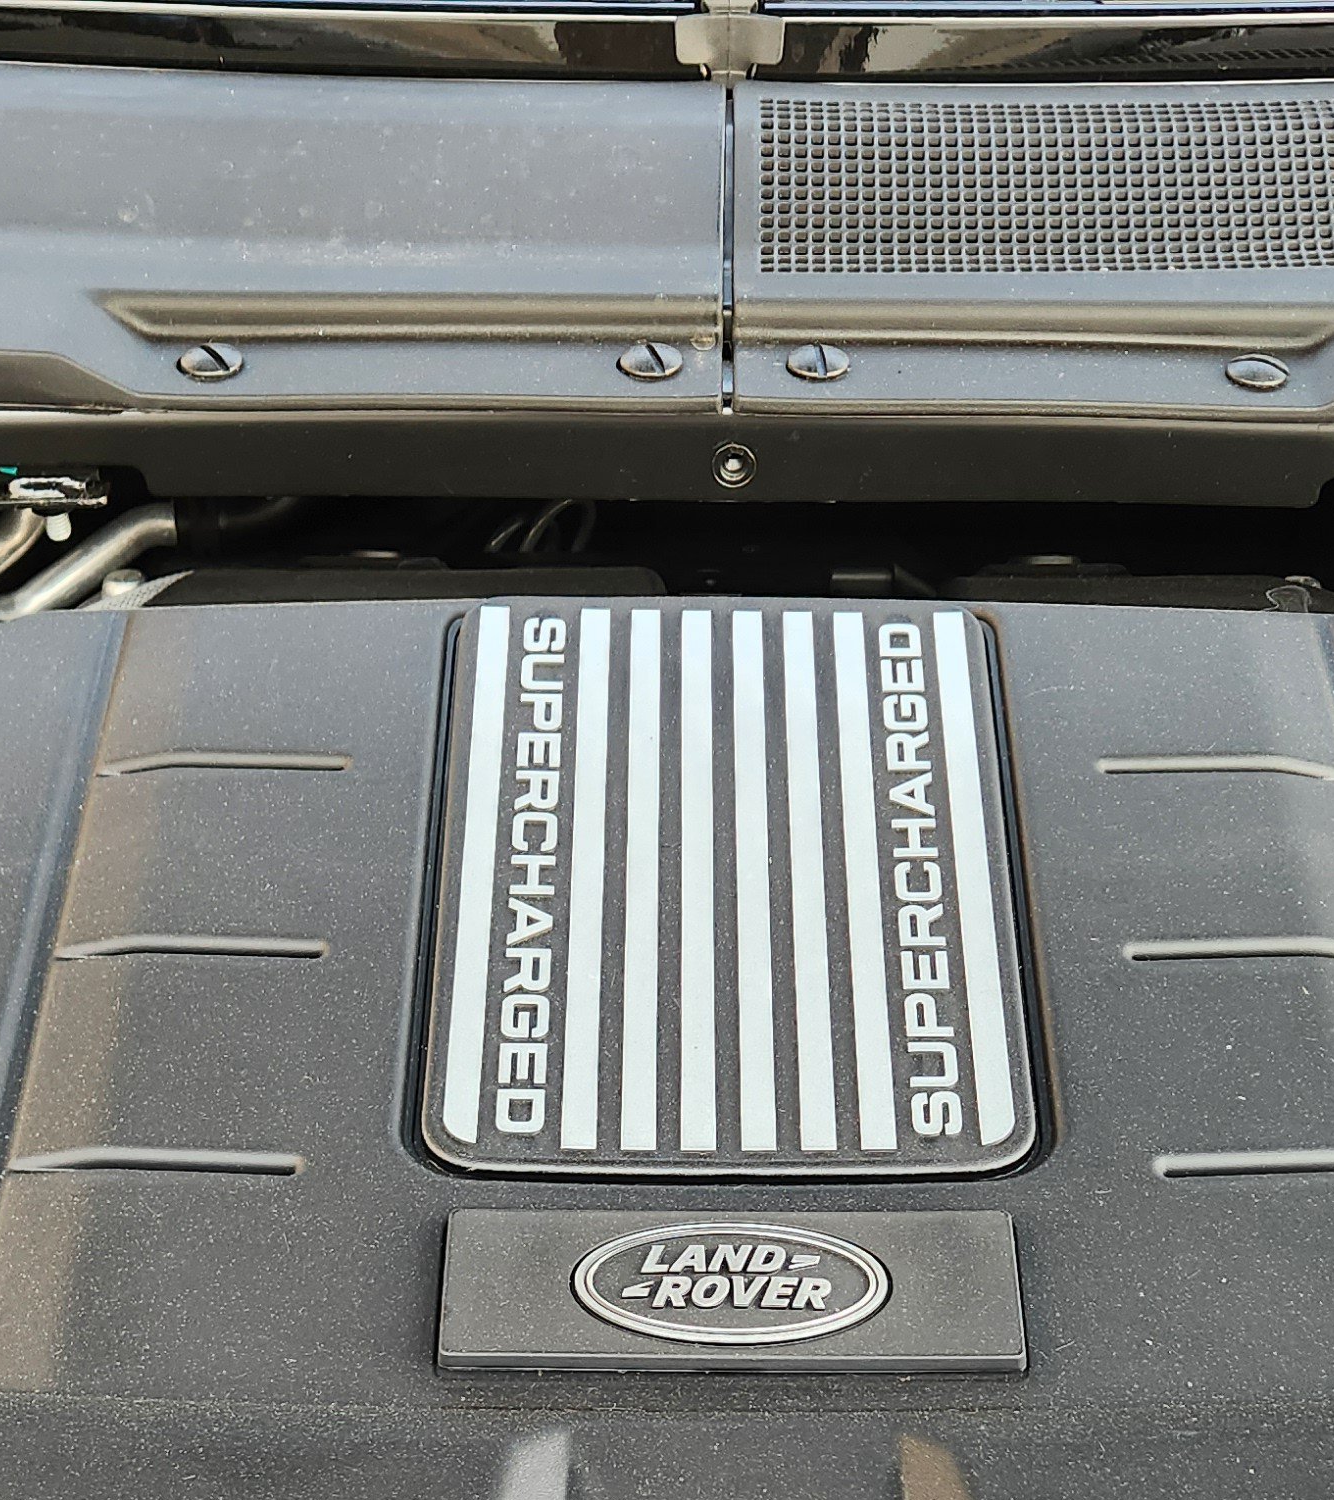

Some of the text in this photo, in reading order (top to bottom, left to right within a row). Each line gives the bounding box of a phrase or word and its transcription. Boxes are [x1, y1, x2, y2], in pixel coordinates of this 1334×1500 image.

[494, 615, 568, 1136] SUPERCHARGED
[878, 621, 964, 1137] SUPERCHARGED
[640, 1243, 788, 1274] LAND
[651, 1274, 832, 1310] ROVER
